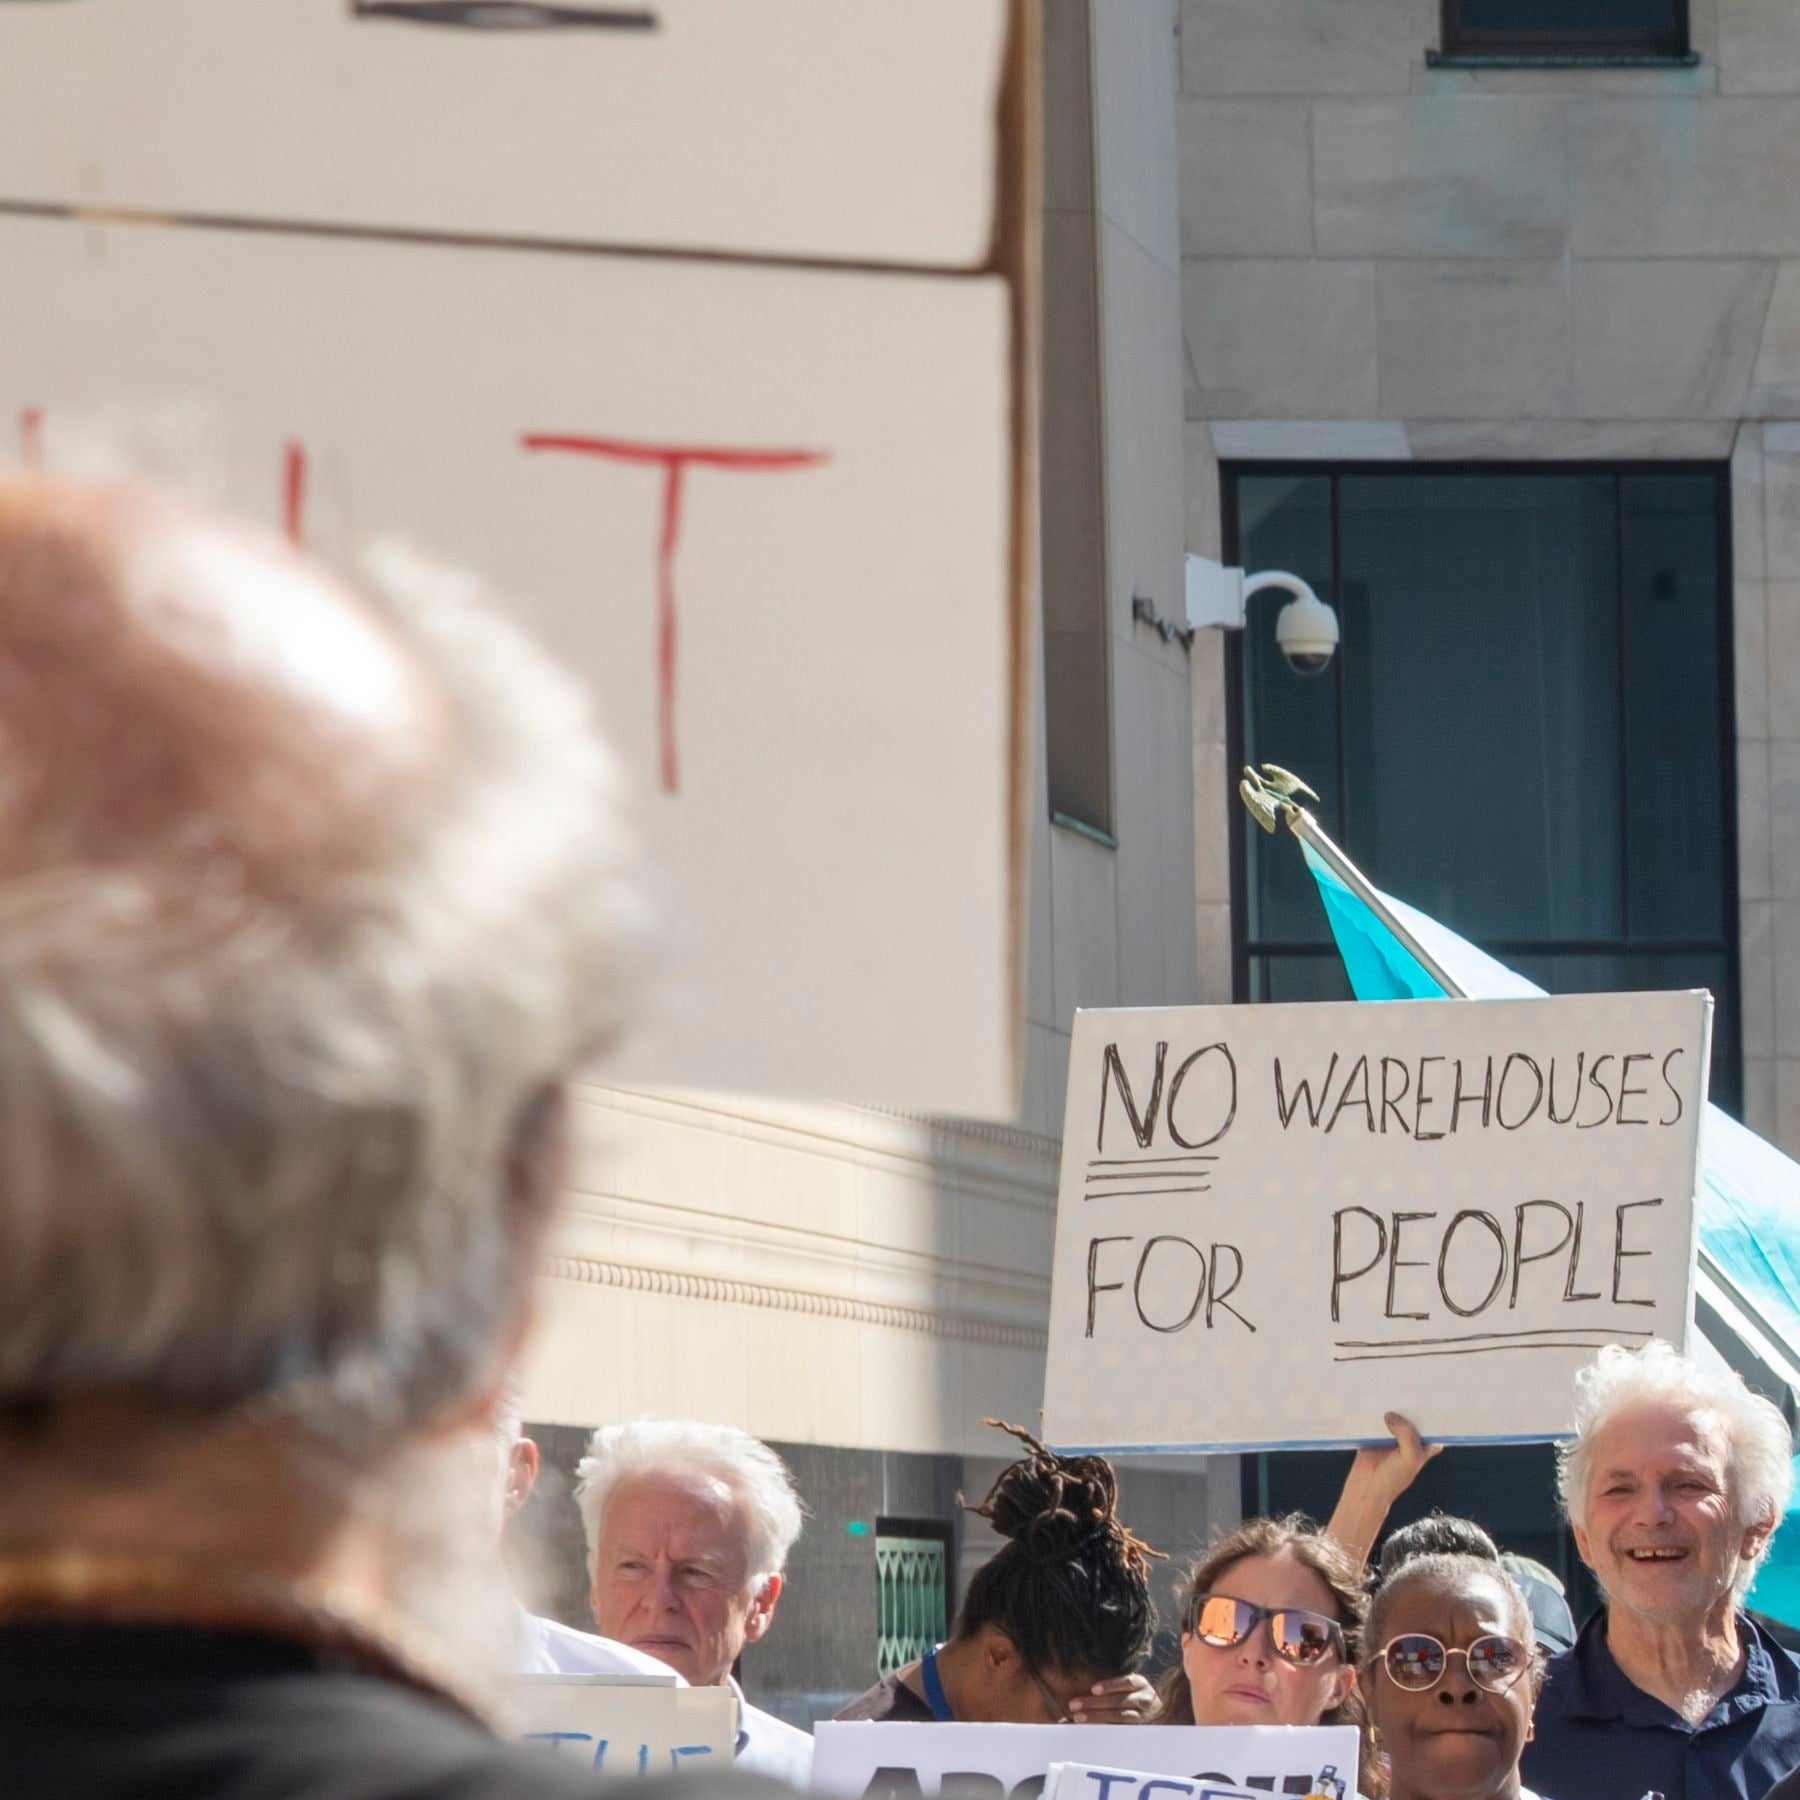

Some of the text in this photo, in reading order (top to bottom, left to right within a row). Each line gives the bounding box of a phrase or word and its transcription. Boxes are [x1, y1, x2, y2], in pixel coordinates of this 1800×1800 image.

[1097, 1040, 1685, 1154] NO WAREHOUSES
[1085, 1198, 1663, 1338] FOR PEOPLE
